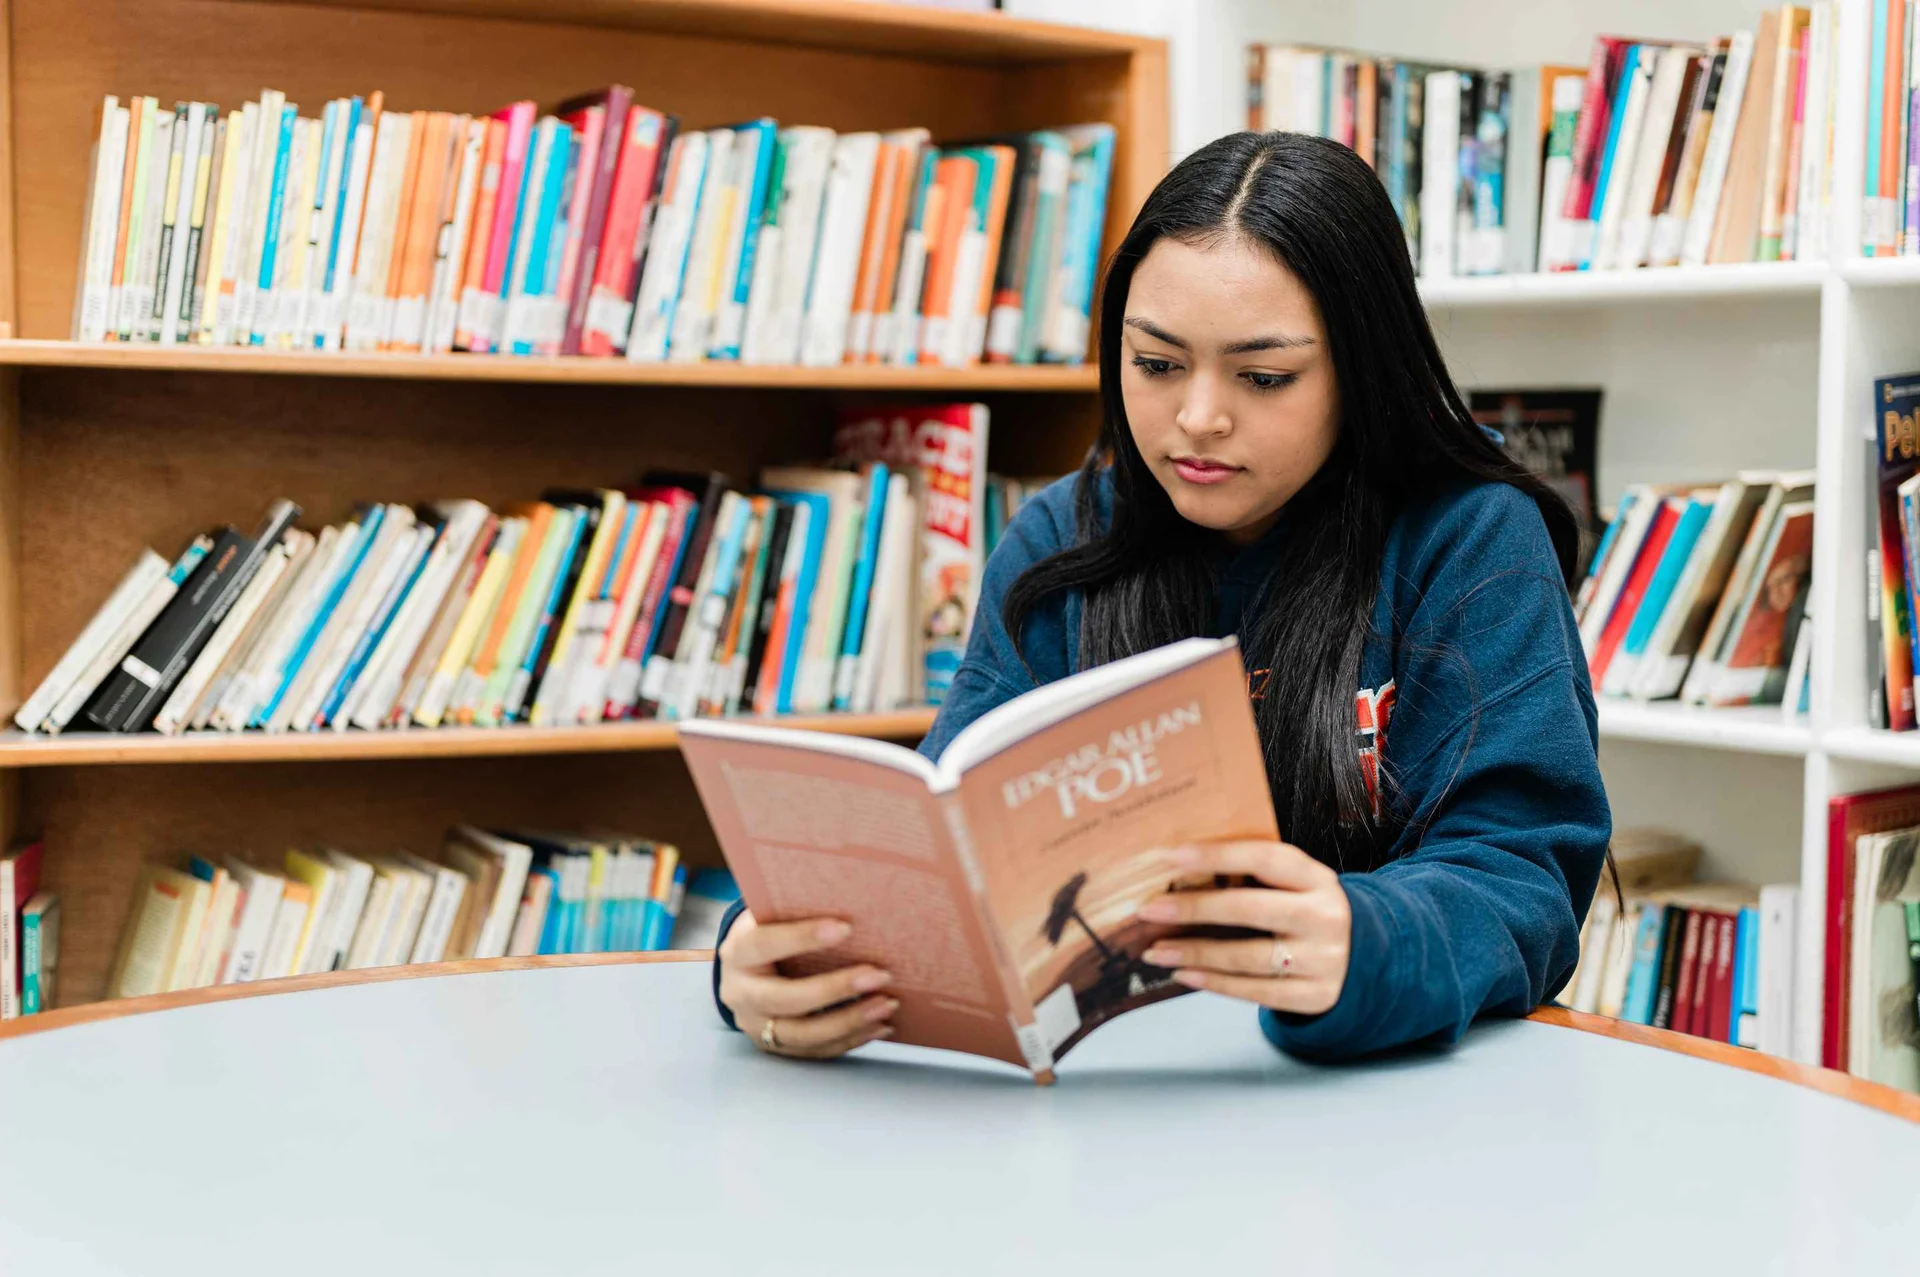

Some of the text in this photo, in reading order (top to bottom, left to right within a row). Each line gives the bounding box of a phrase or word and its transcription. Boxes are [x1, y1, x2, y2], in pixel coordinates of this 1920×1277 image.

[1002, 743, 1102, 809] EDGAR
[1105, 699, 1201, 757] ALLAN
[1056, 745, 1164, 820] POE
